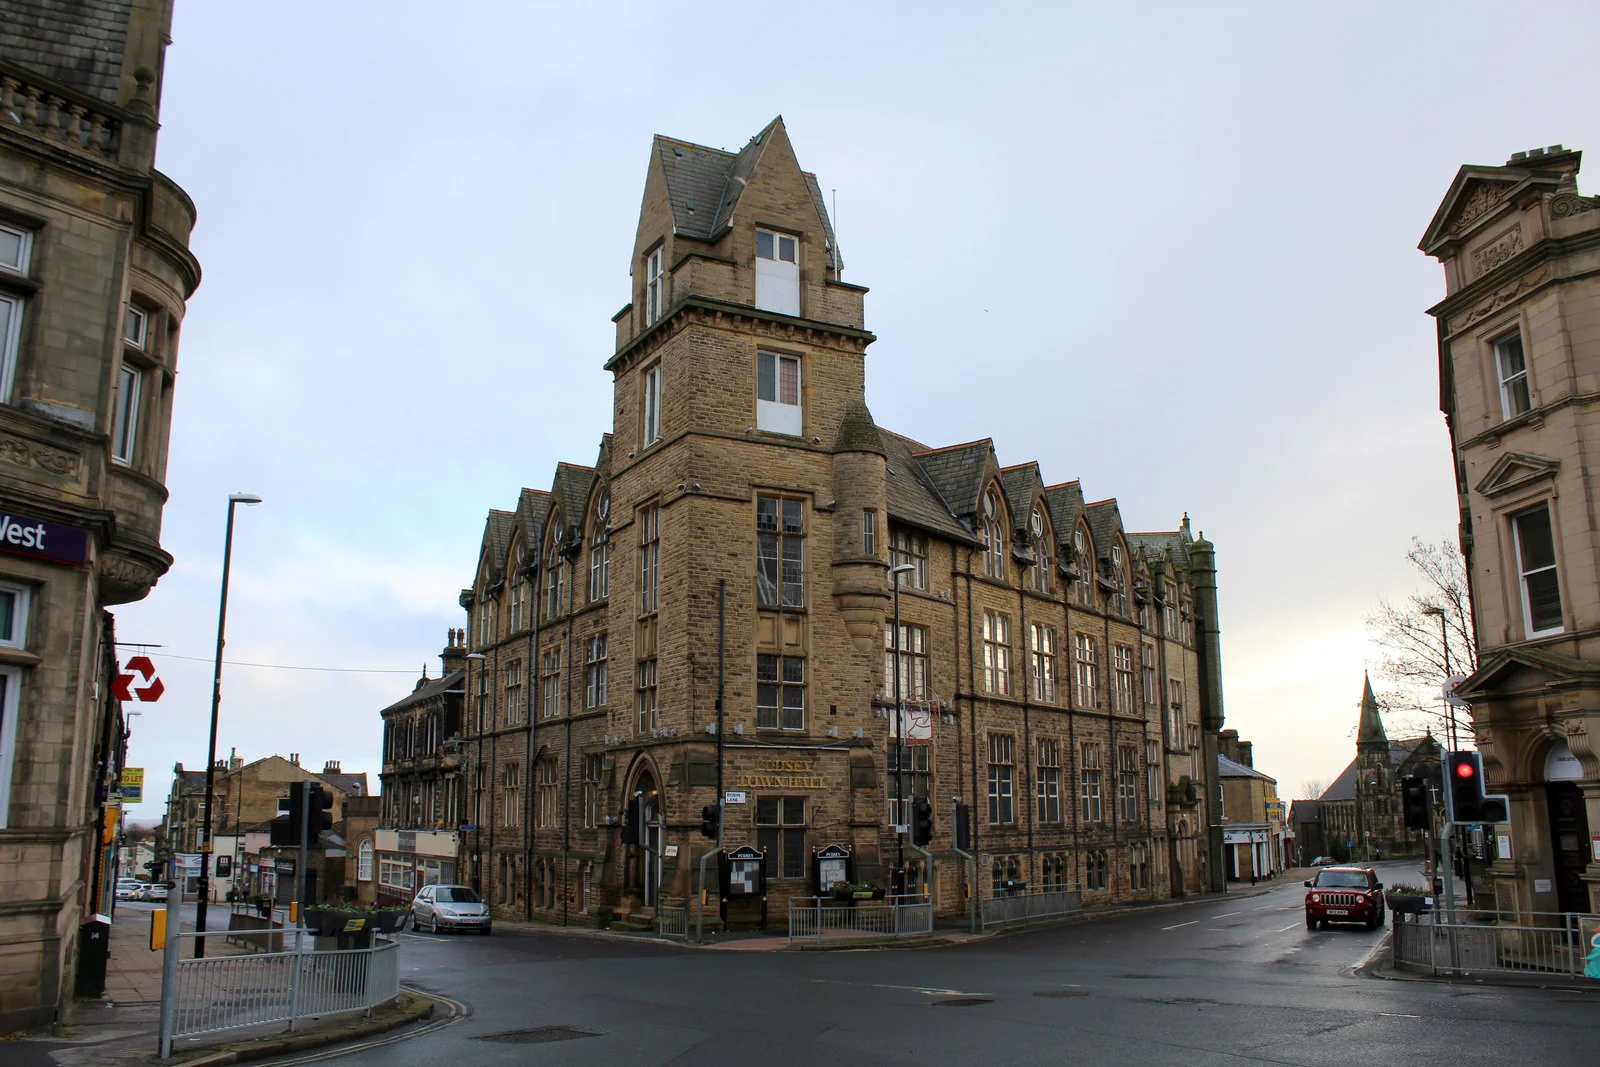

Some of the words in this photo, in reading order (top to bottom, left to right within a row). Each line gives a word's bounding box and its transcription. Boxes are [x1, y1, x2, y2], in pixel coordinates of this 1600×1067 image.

[755, 760, 813, 772] PUDSEY
[121, 775, 130, 783] TO
[131, 775, 143, 783] LET
[736, 775, 788, 788] TOWN
[789, 776, 828, 789] HALL
